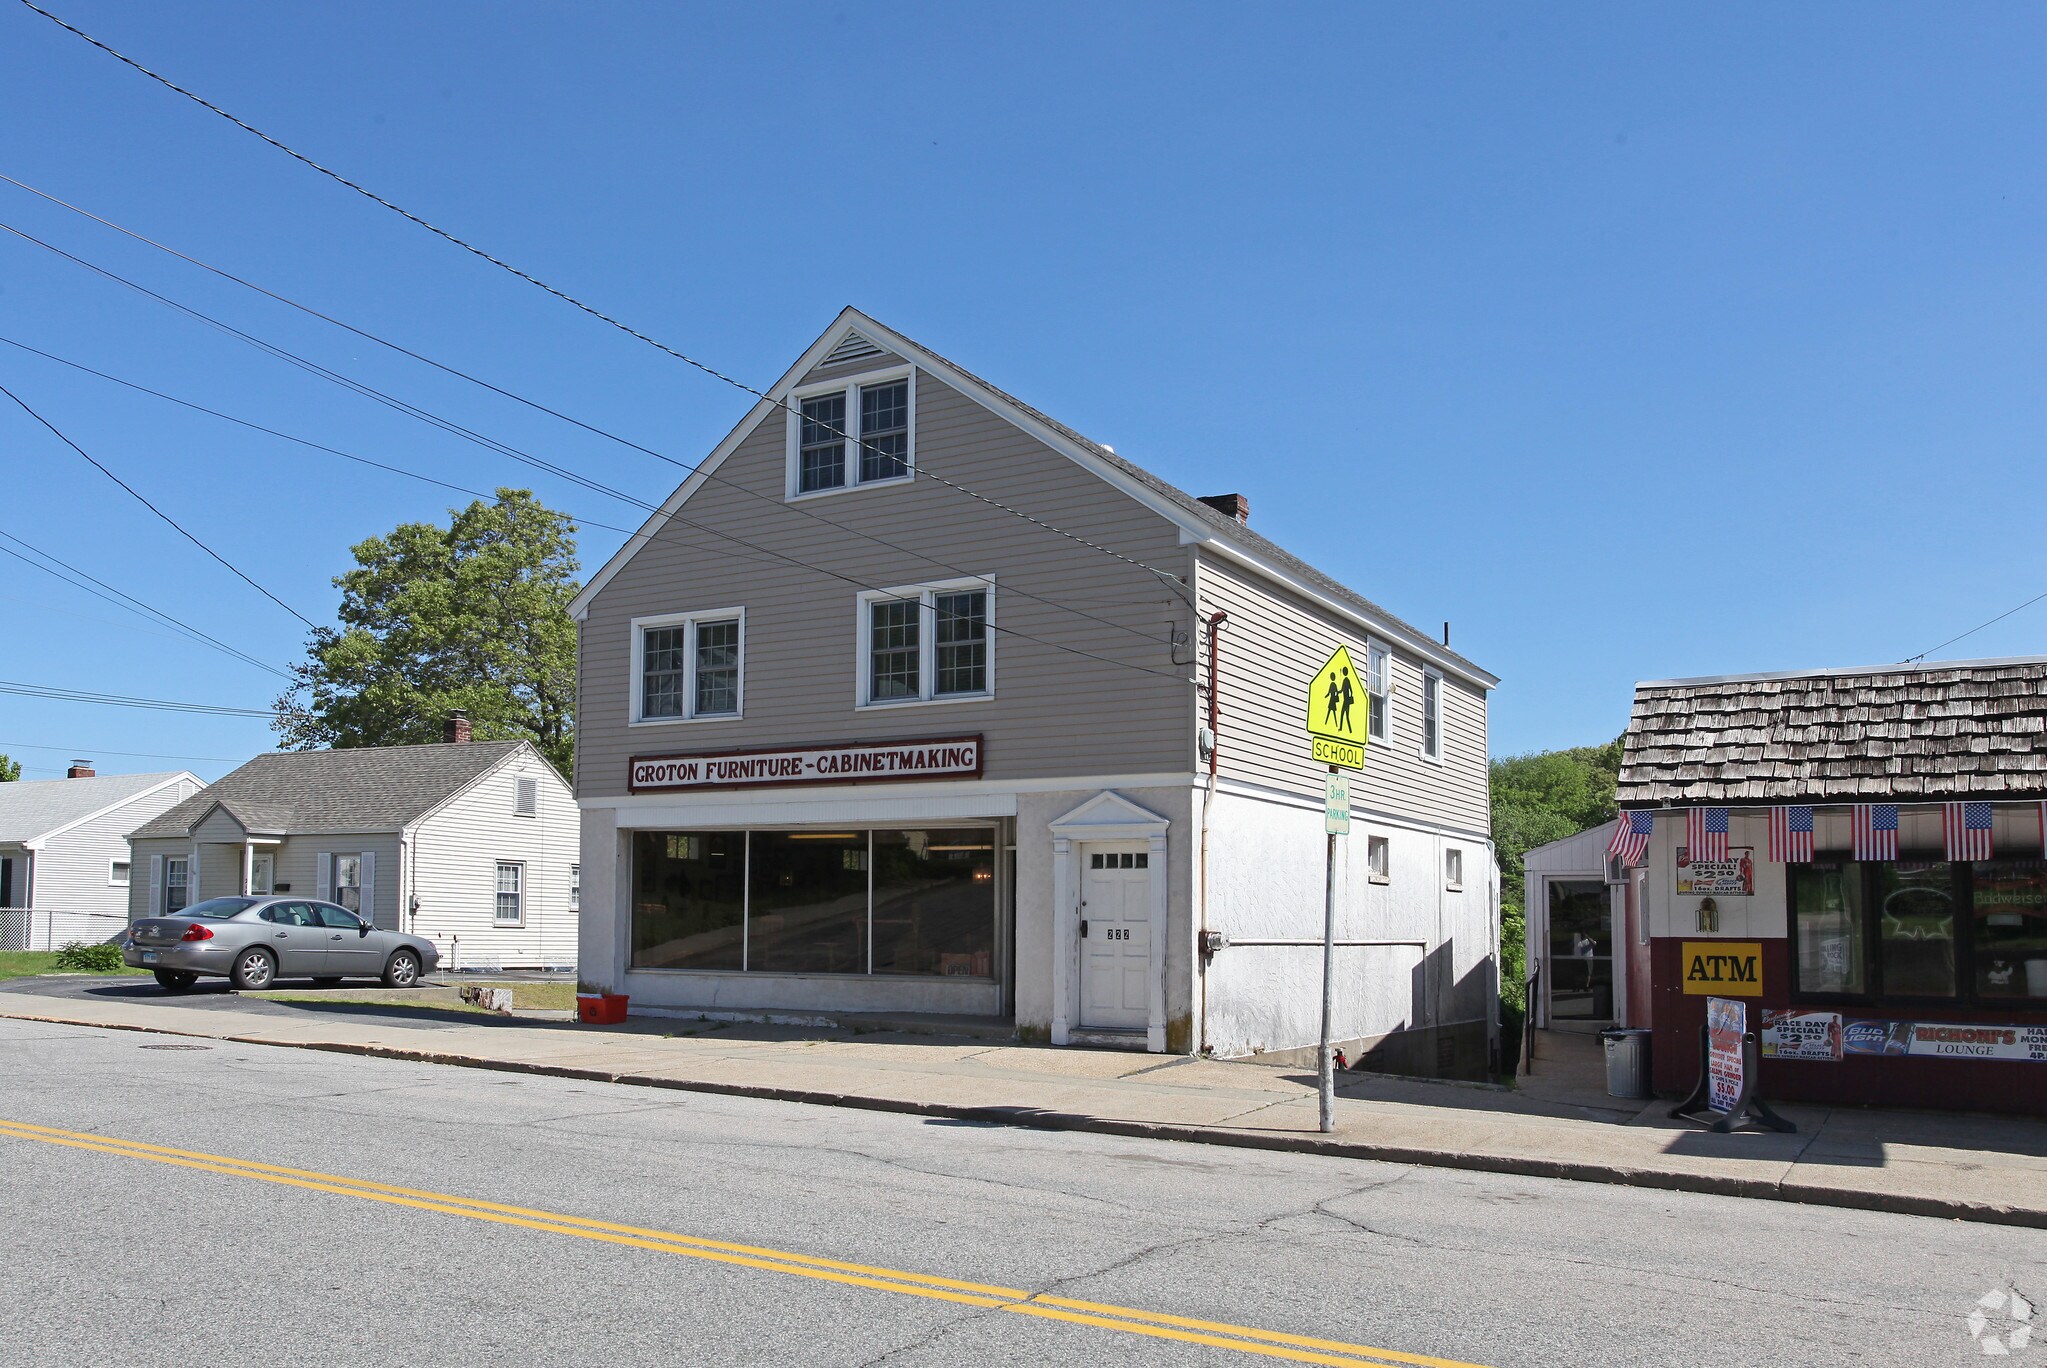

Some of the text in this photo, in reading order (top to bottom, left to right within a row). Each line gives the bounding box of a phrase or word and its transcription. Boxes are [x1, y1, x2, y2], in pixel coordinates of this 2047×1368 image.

[1315, 742, 1360, 765] SCHOOL
[634, 763, 699, 783] GROTON
[1327, 808, 1348, 822] PARKING
[1107, 929, 1129, 939] 222
[947, 965, 969, 975] OPEN
[1687, 955, 1758, 982] ATM
[1848, 1027, 1884, 1035] BUD
[1844, 1034, 1886, 1042] LIGHT
[1936, 1044, 1994, 1056] LOUNGE
[1724, 1071, 1742, 1081] GRINDER
[1717, 1082, 1735, 1096] $5.00
